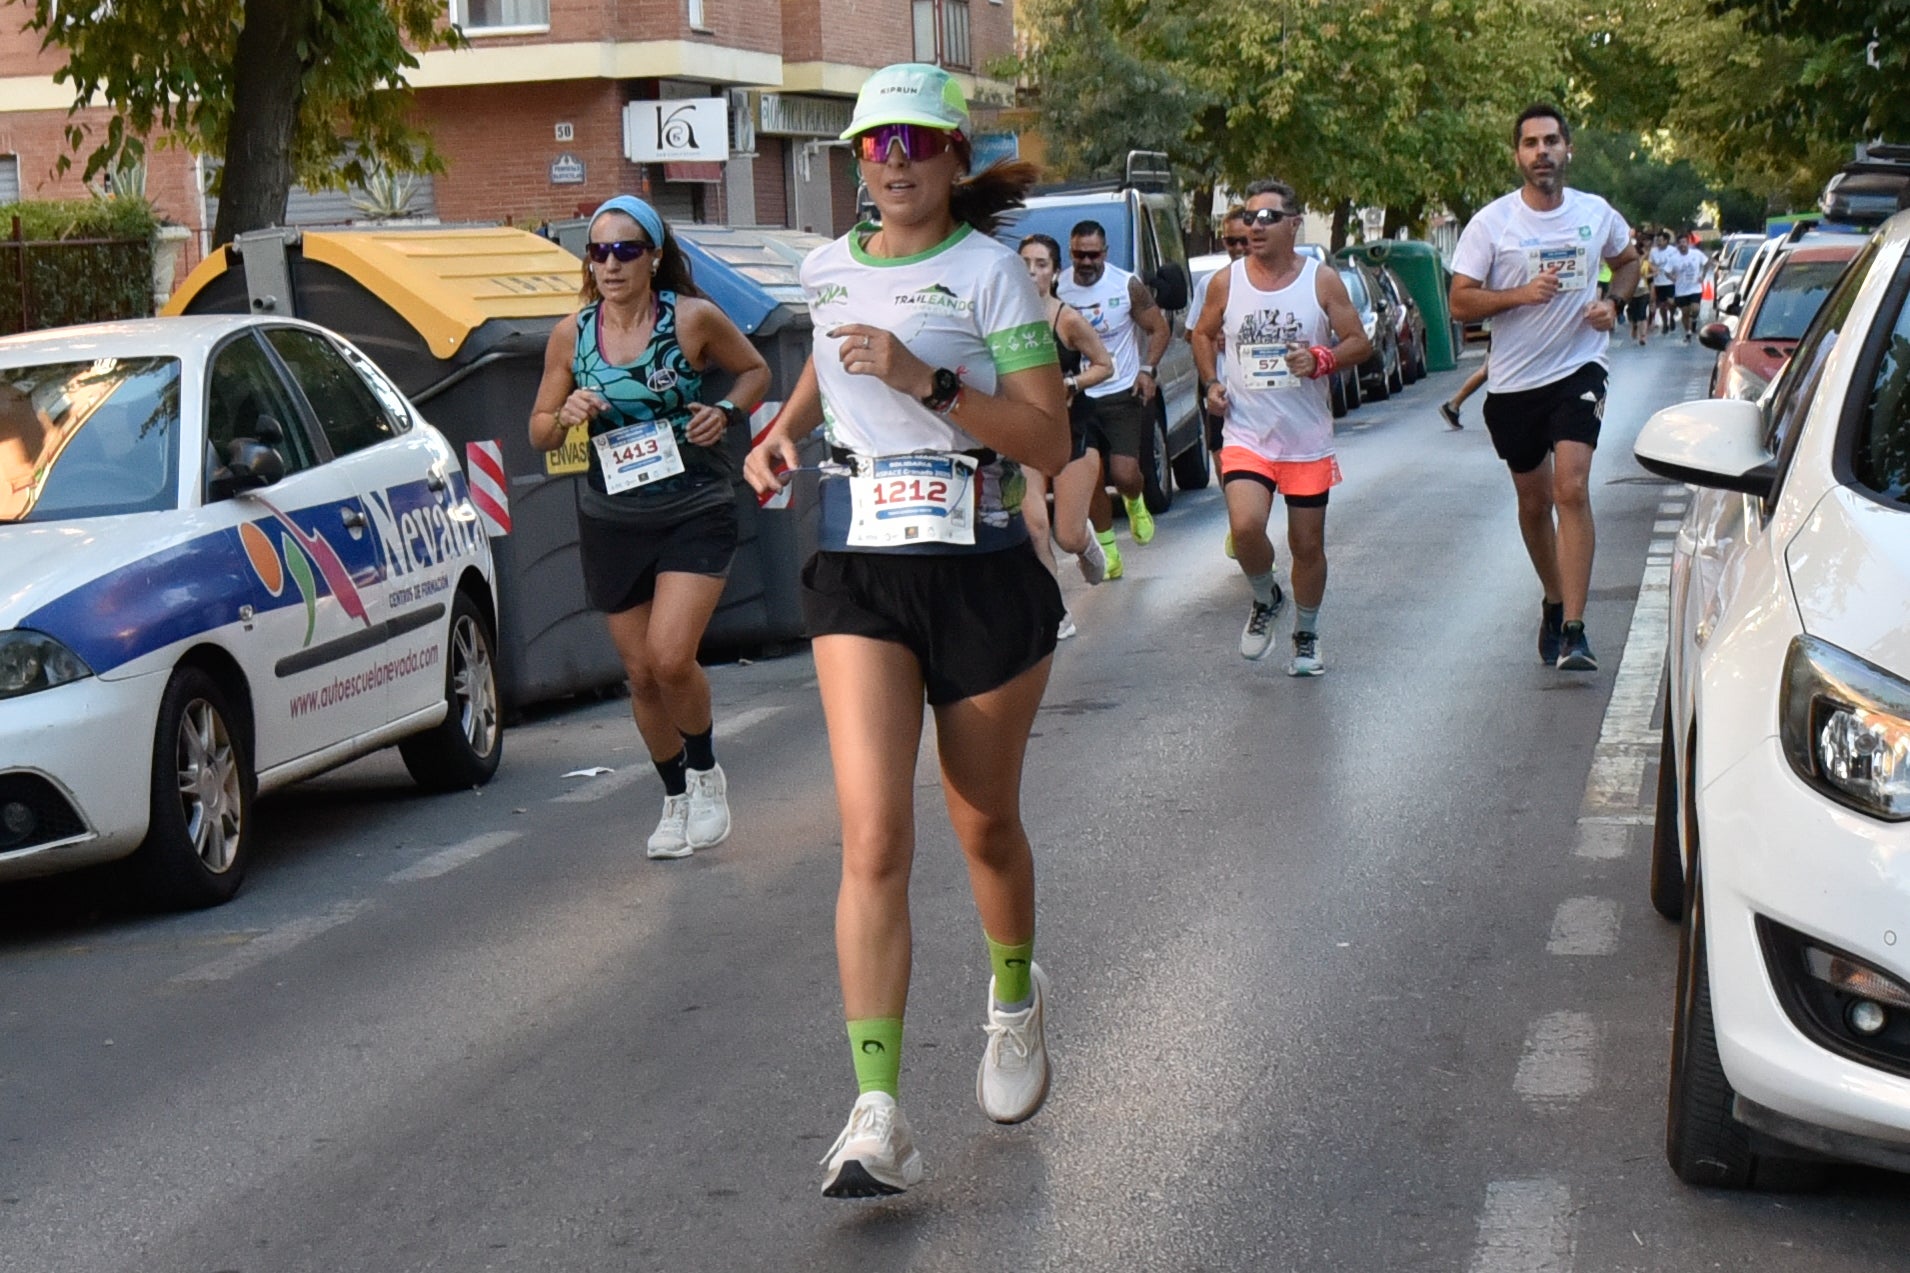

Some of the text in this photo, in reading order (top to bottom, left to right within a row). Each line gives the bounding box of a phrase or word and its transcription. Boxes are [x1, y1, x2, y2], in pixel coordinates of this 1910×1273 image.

[557, 125, 571, 138] 50
[1258, 359, 1279, 370] 57
[550, 442, 589, 466] ENVAS
[612, 439, 658, 465] 1413
[873, 479, 947, 505] 1212
[289, 644, 439, 719] www.autoescuelanevada.com
